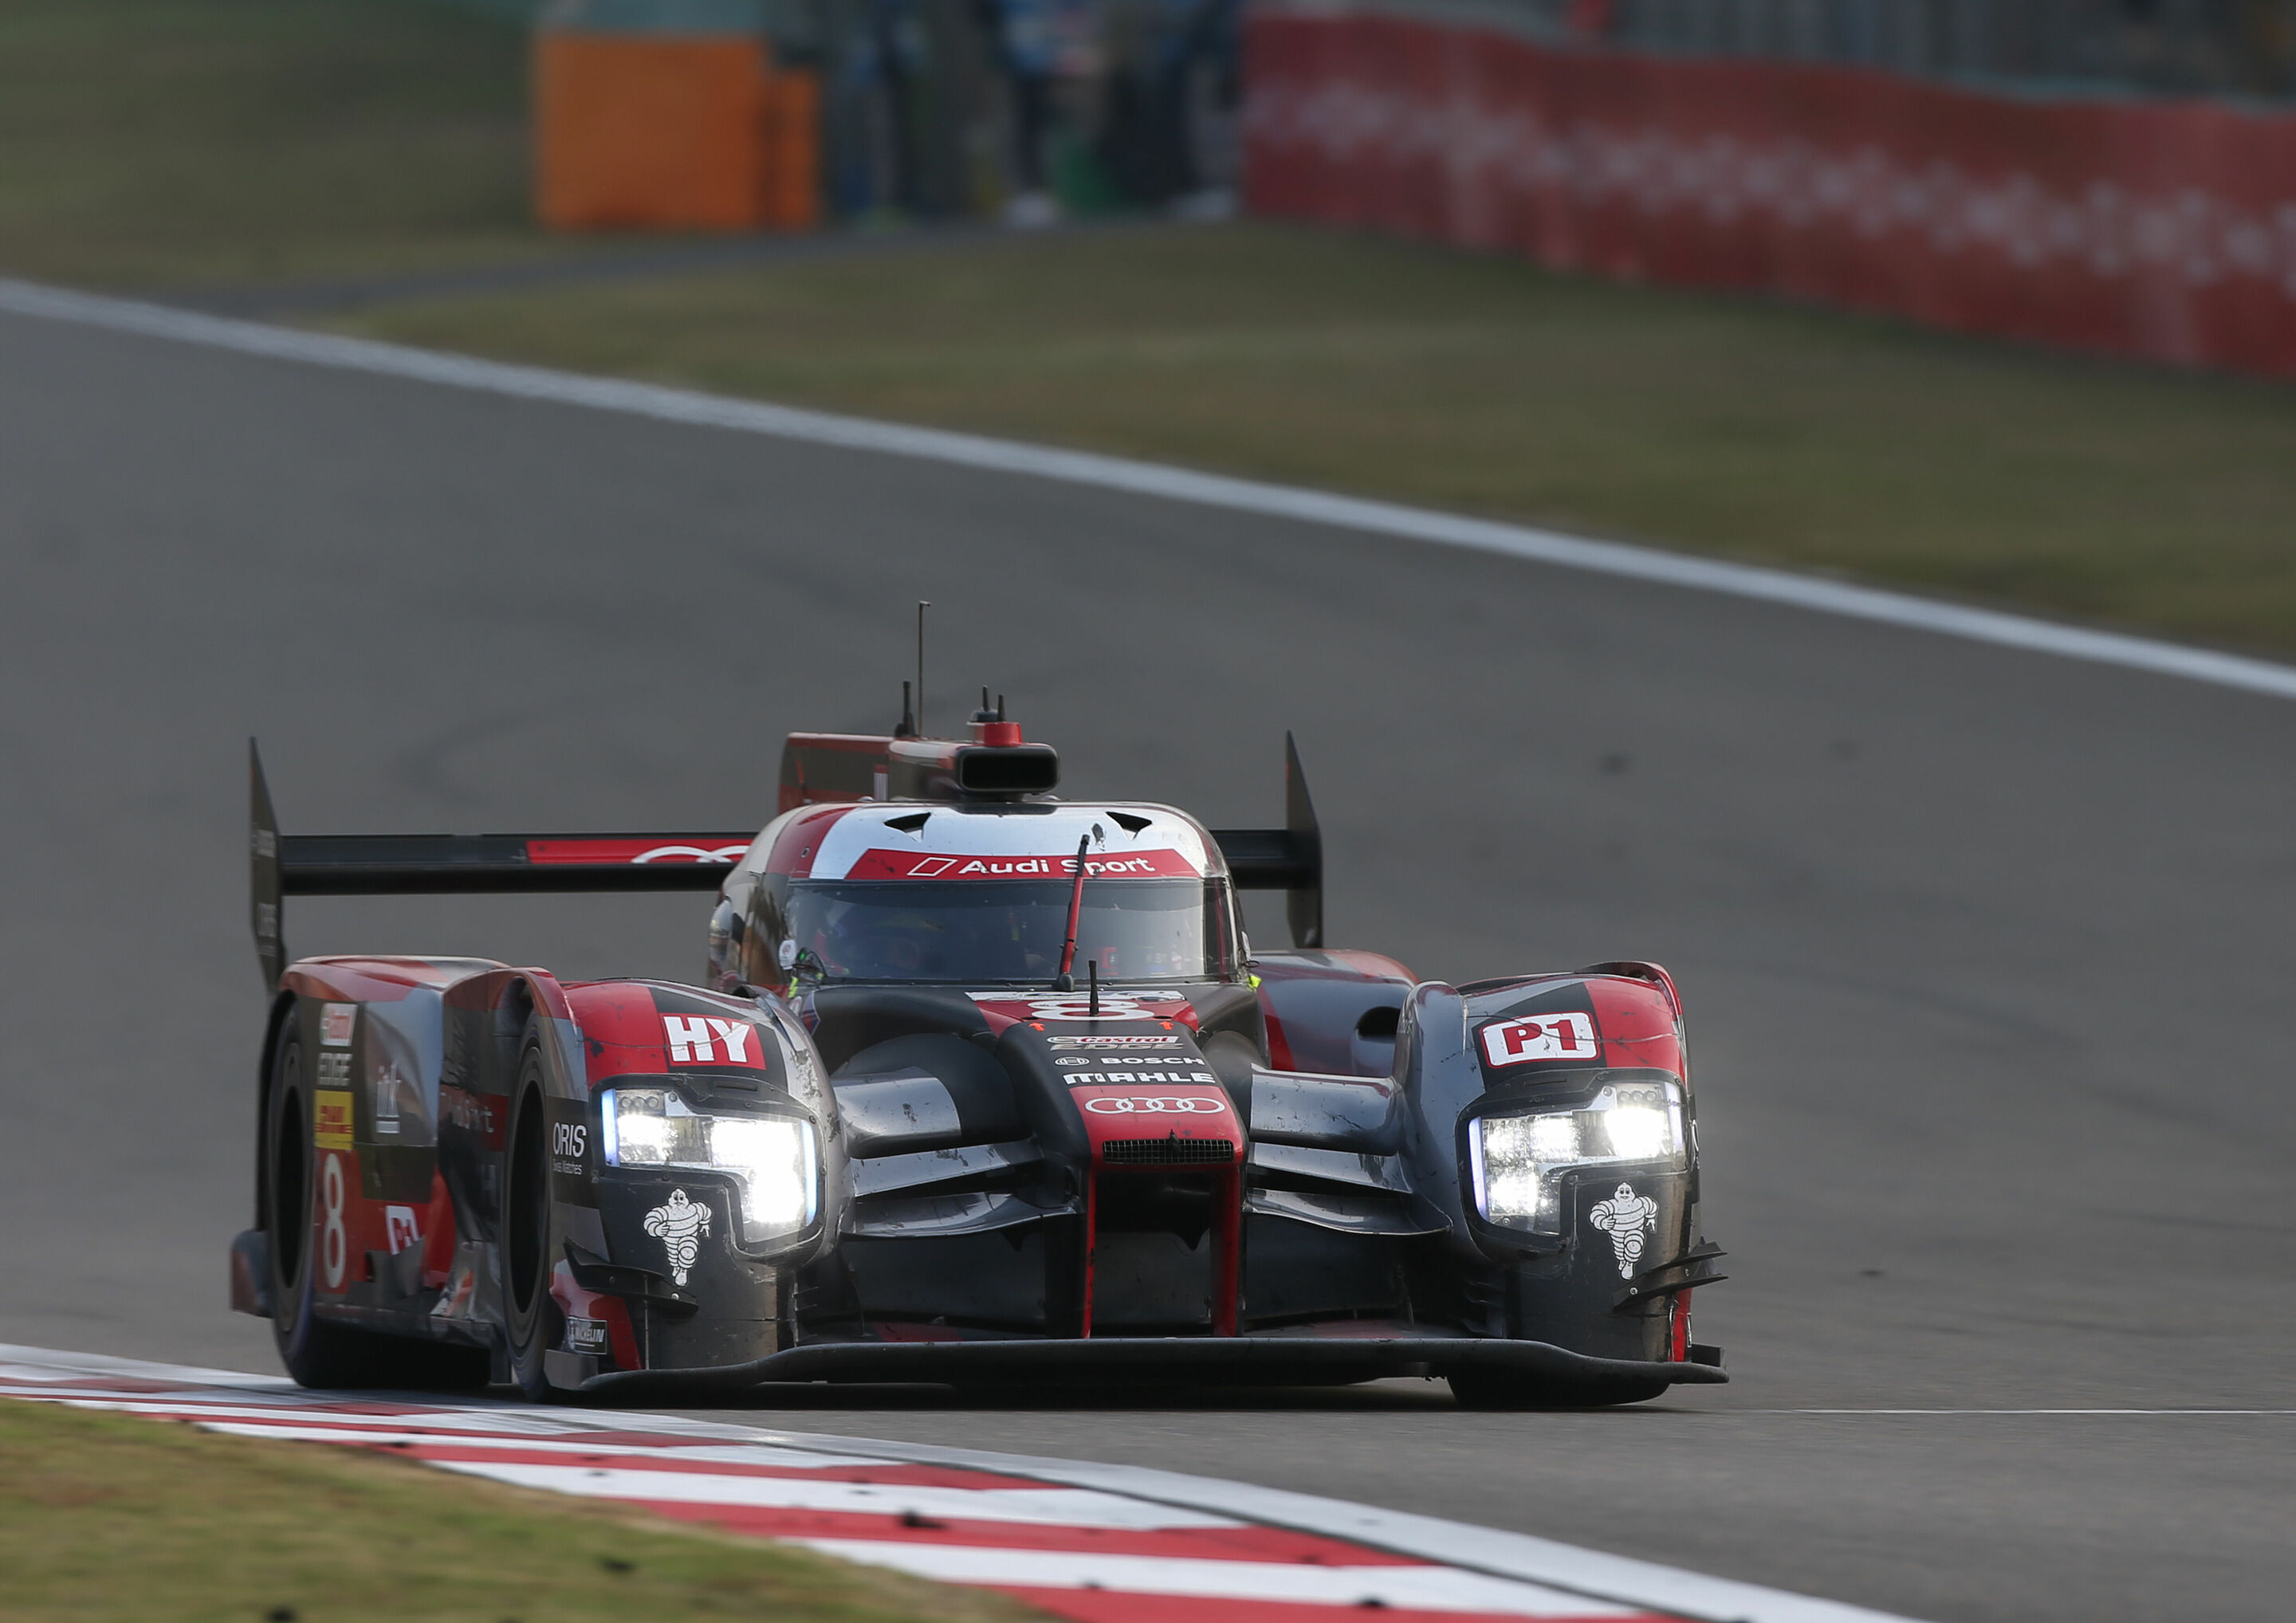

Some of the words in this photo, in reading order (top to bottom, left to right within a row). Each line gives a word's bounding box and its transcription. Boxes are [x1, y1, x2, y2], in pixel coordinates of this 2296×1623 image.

[958, 857, 1050, 874] Audi
[1060, 856, 1156, 878] Sport
[1028, 1000, 1155, 1021] 8
[663, 1016, 751, 1063] HY
[1049, 1043, 1185, 1052] EDGE
[1079, 1035, 1172, 1044] Castrol
[1502, 1020, 1578, 1055] P1
[1100, 1056, 1206, 1066] BOSCH
[1063, 1071, 1217, 1085] MAHLE
[552, 1122, 587, 1157] ORIS
[323, 1153, 347, 1288] 8
